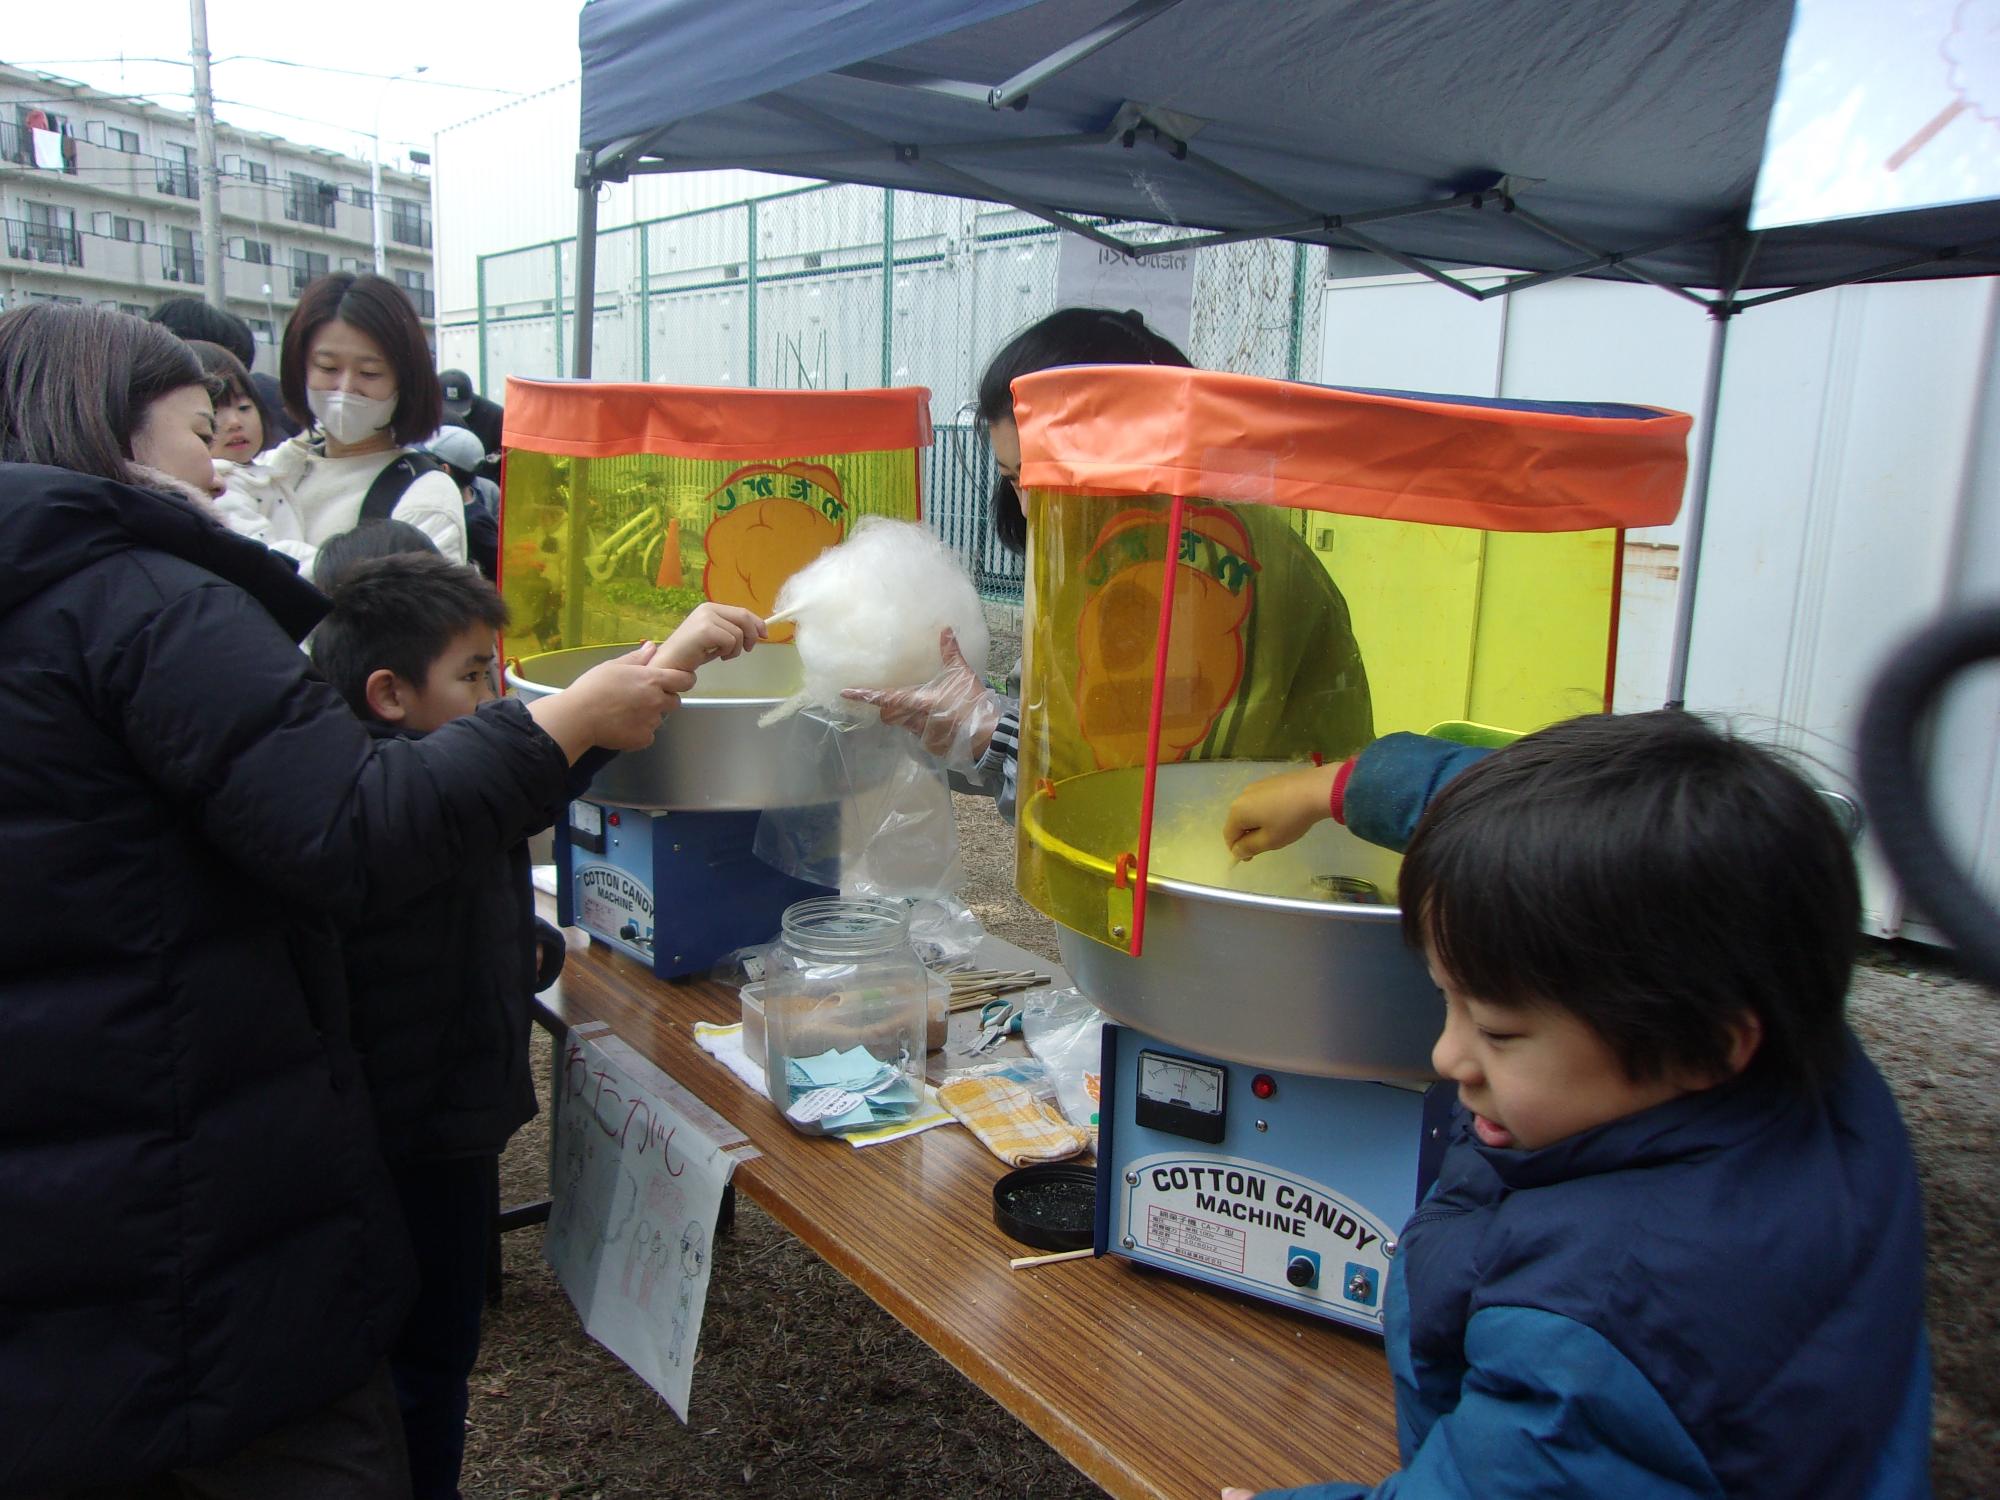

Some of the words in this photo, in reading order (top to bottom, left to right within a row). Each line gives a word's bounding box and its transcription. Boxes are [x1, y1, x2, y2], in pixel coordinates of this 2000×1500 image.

[583, 870, 620, 891] COTTON
[622, 880, 654, 919] CANDY
[597, 886, 634, 912] MACHINE
[565, 1043, 684, 1177] わたがし
[1152, 1166, 1266, 1201] COTTON
[1276, 1185, 1378, 1251] CANDY
[1196, 1192, 1306, 1238] MACHINE
